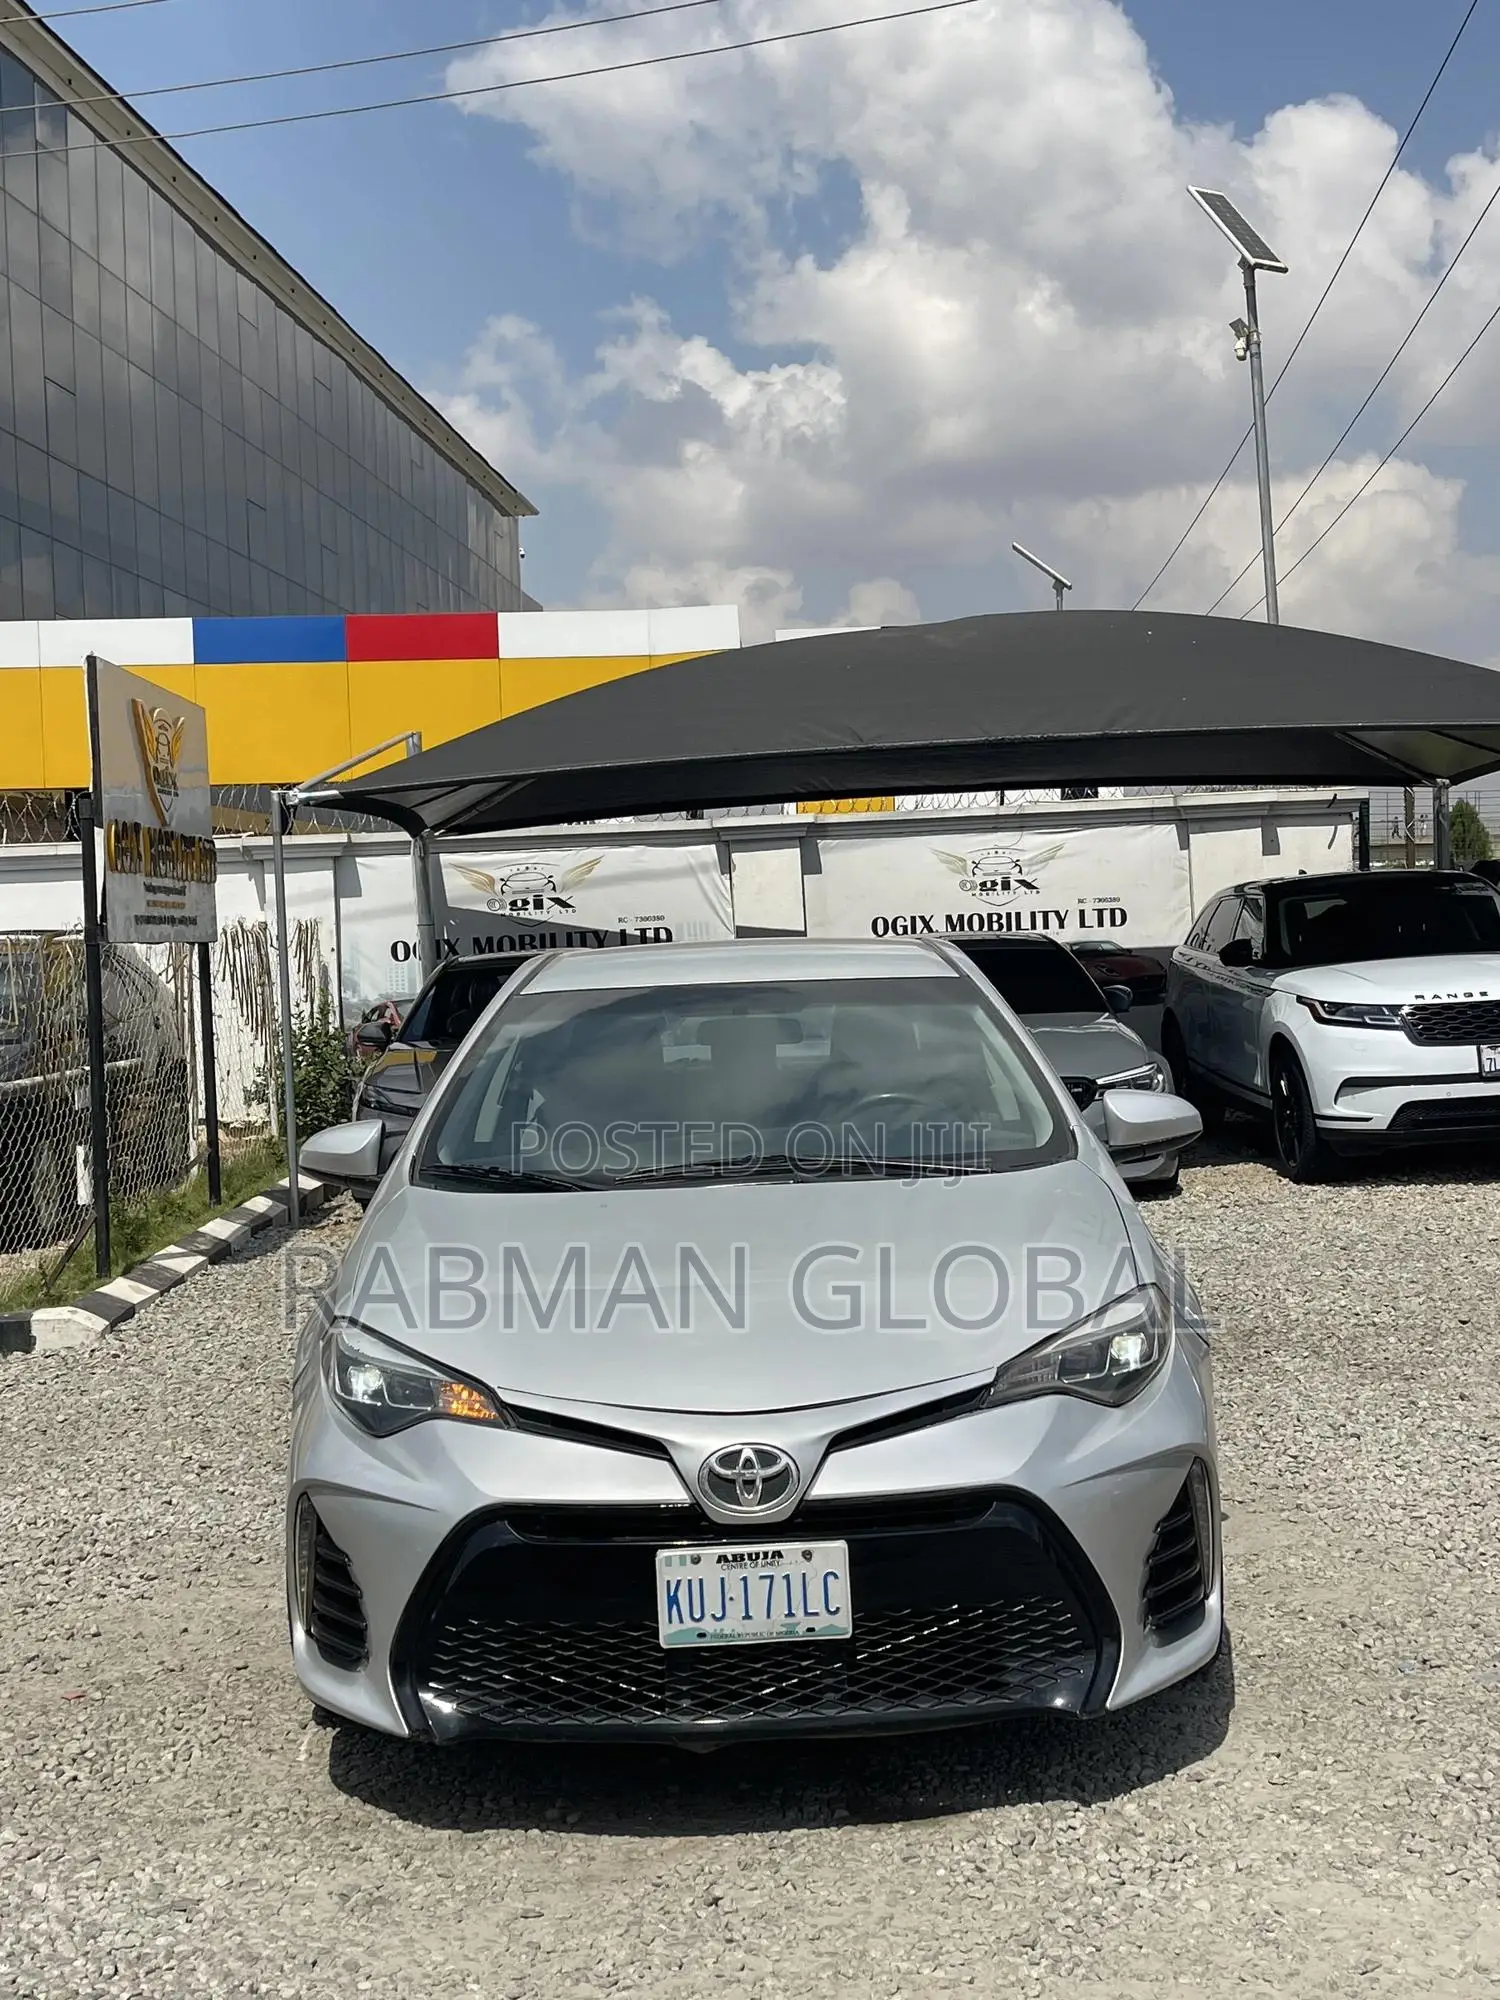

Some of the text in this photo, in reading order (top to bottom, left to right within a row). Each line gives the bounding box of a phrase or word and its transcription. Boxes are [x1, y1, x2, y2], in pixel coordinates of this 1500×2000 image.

[871, 907, 1128, 938] OGIX MOBILITY LTD
[1414, 990, 1489, 1001] RANGE
[716, 1550, 784, 1564] ABUJA
[721, 1559, 781, 1571] CENTRE OF UNITY
